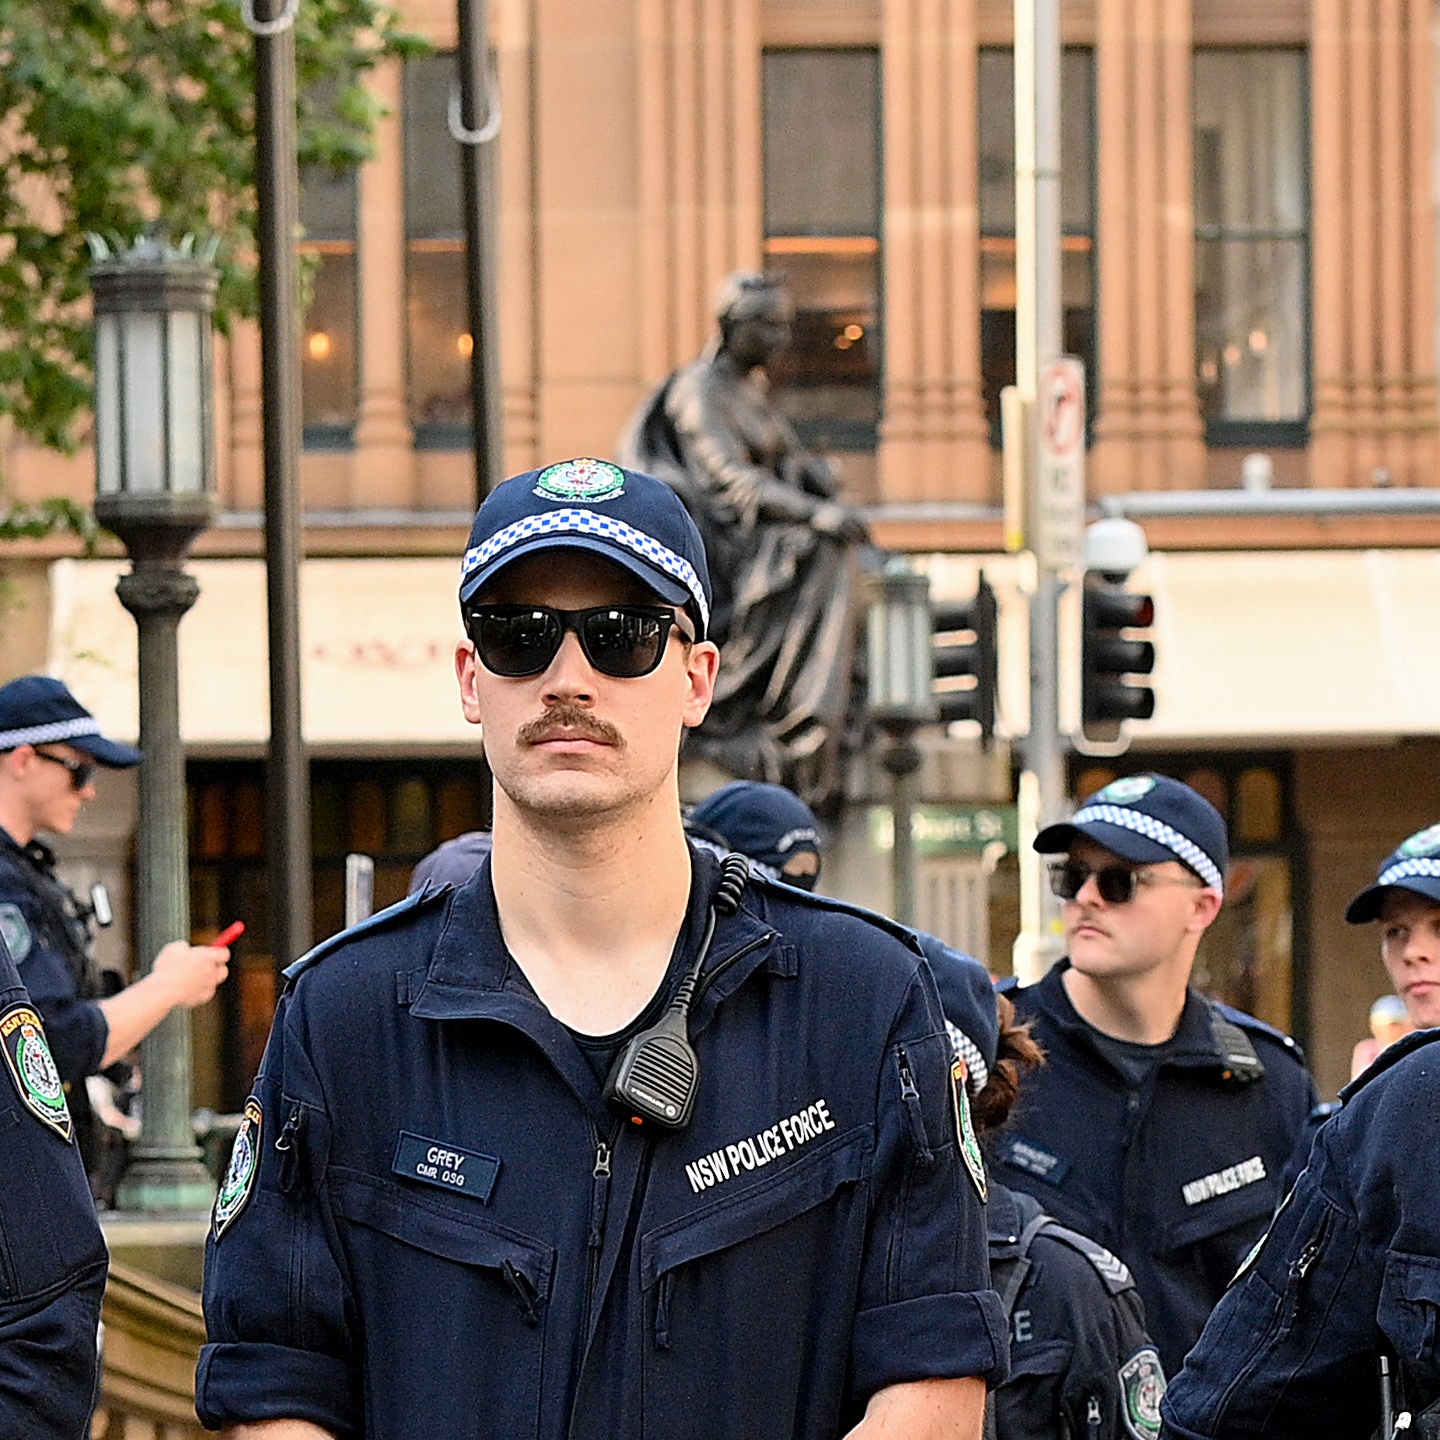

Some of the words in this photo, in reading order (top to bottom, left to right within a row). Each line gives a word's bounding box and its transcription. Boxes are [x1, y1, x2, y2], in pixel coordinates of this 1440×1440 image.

[427, 1146, 465, 1171] GREY
[685, 1149, 730, 1193] NSW
[725, 1125, 786, 1176] POLICE
[779, 1099, 835, 1150] FORCE
[441, 1170, 465, 1186] OSG
